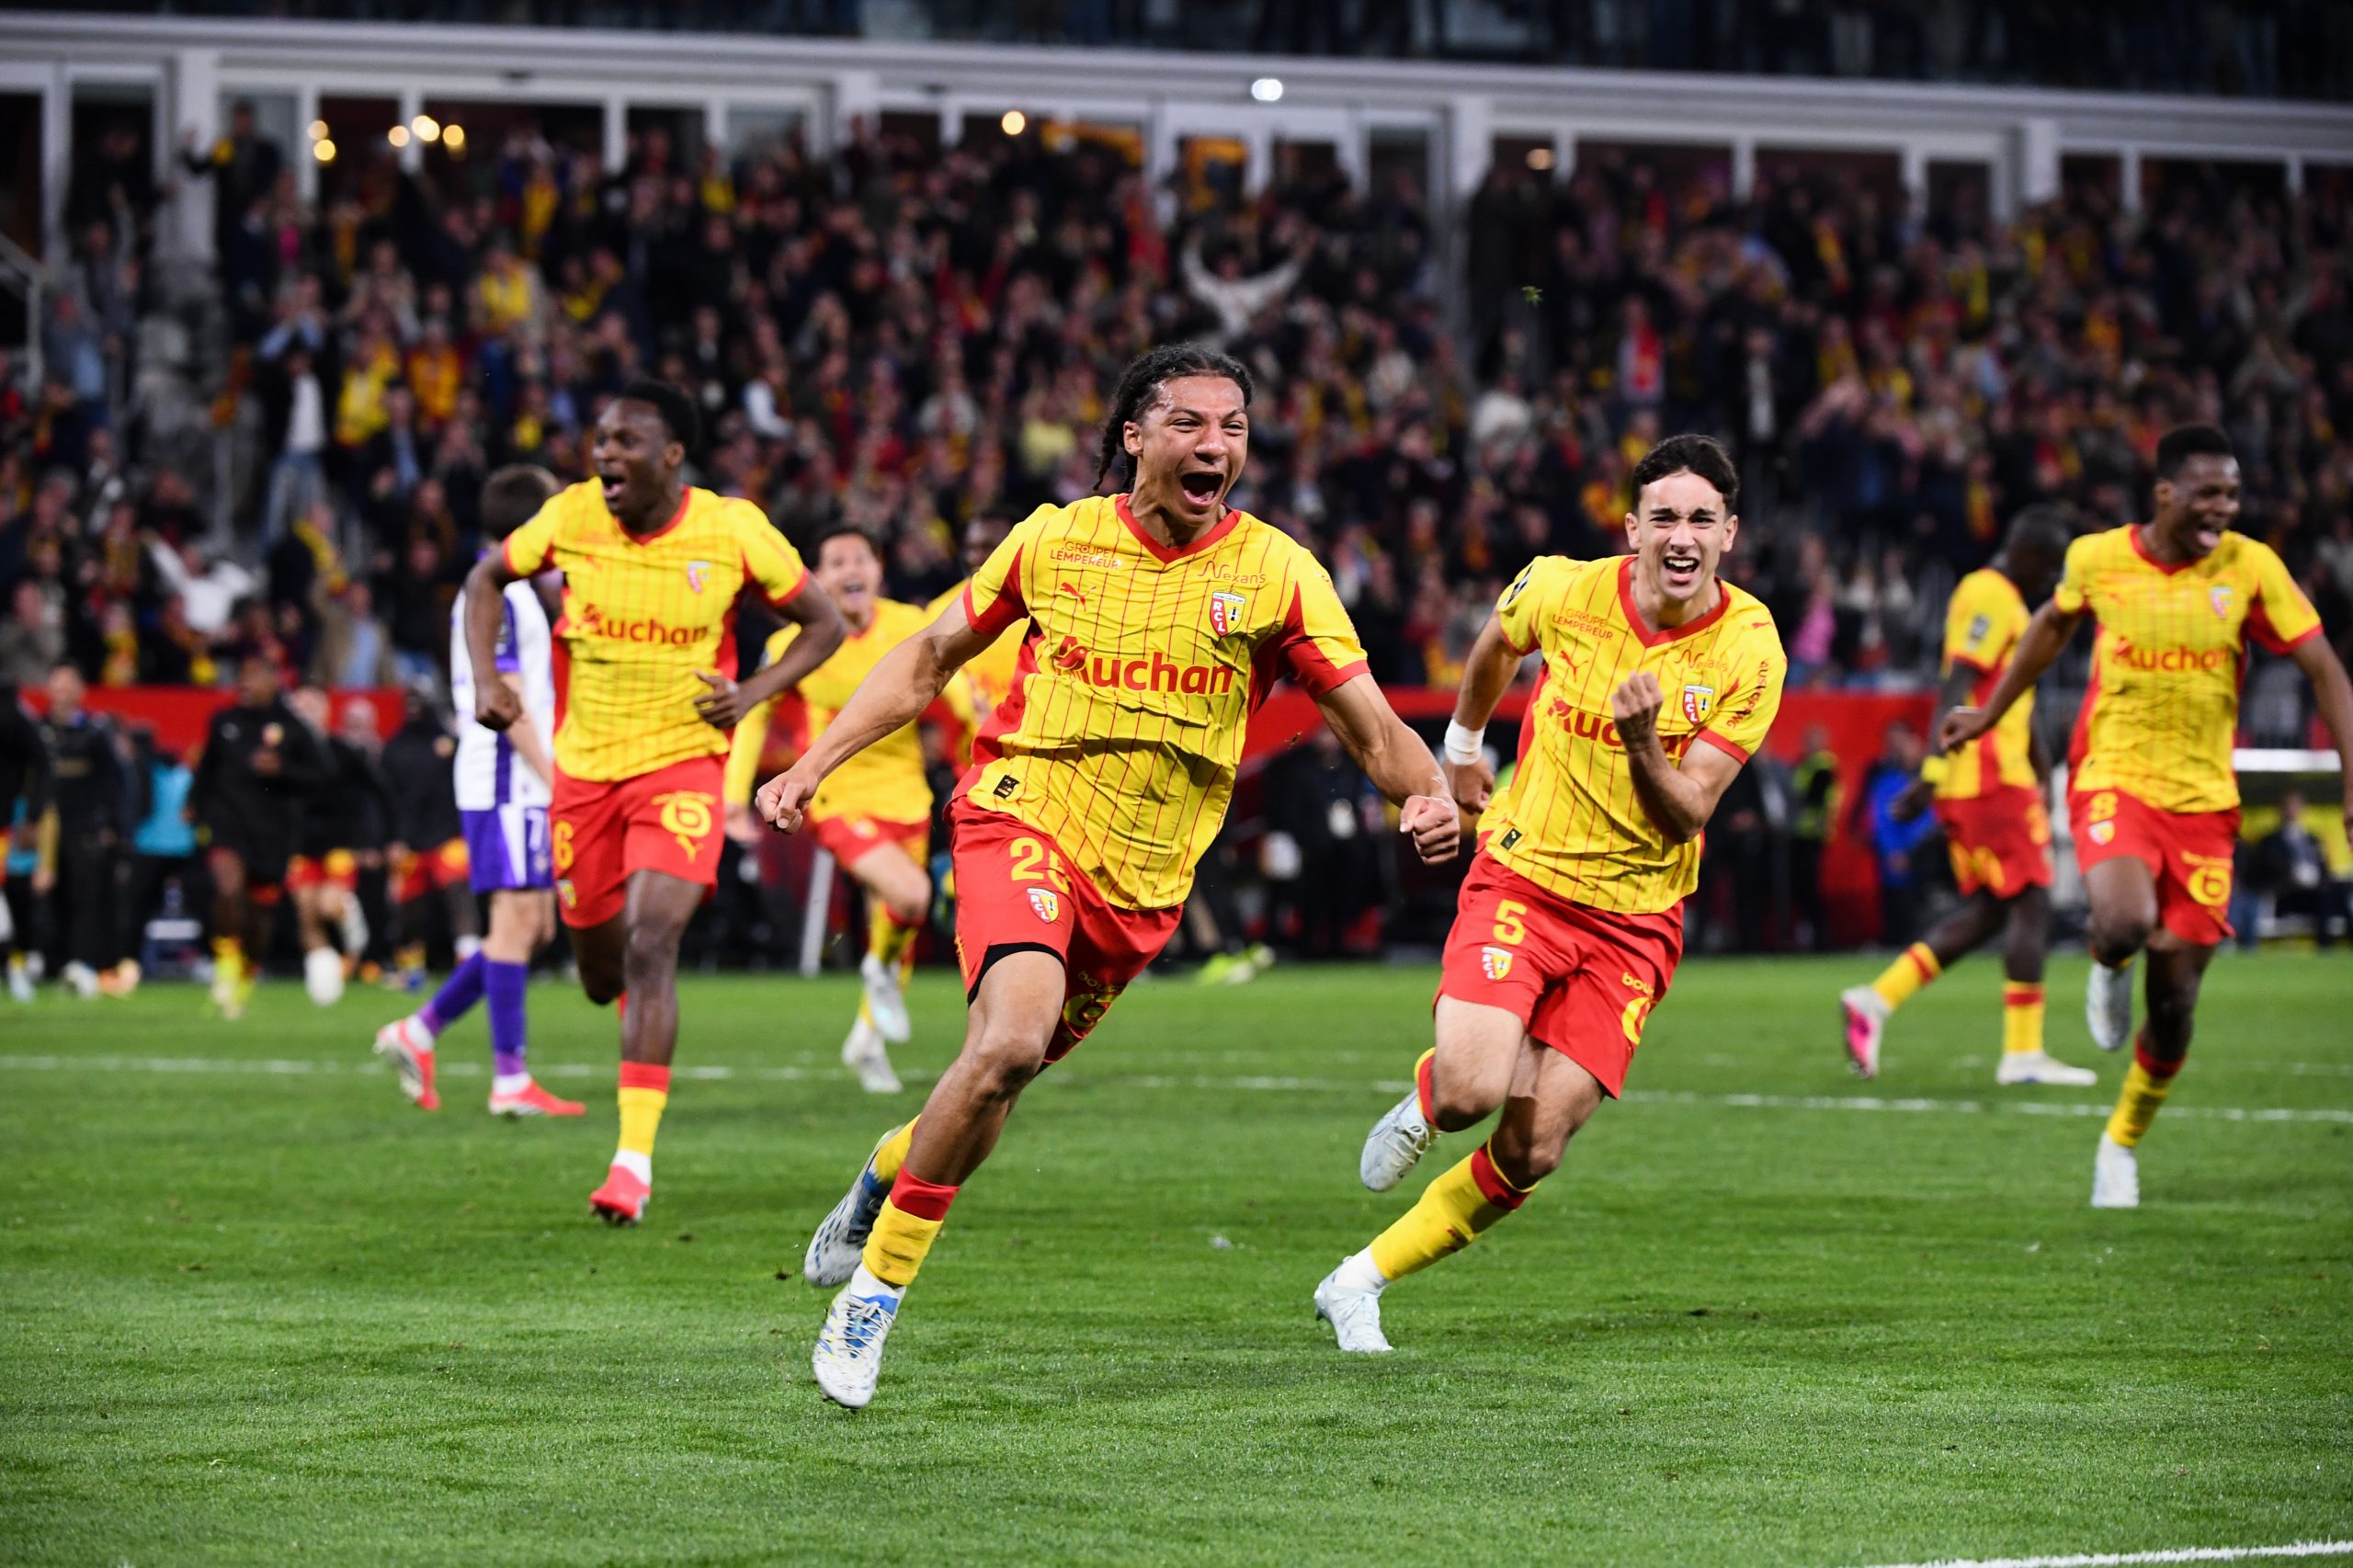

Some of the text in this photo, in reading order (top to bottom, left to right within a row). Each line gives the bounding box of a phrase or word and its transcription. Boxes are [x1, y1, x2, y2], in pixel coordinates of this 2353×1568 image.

[1050, 549, 1119, 570] LEMPEREUR
[1064, 540, 1110, 558] GROUPE
[1198, 560, 1267, 584] Nexans
[1212, 600, 1226, 632] RCL
[1552, 613, 1614, 640] LEMPEREUR
[1565, 608, 1608, 628] GROUPE
[1051, 634, 1233, 695] Auchan
[1684, 693, 1699, 722] RCL
[1492, 898, 1528, 946] 5
